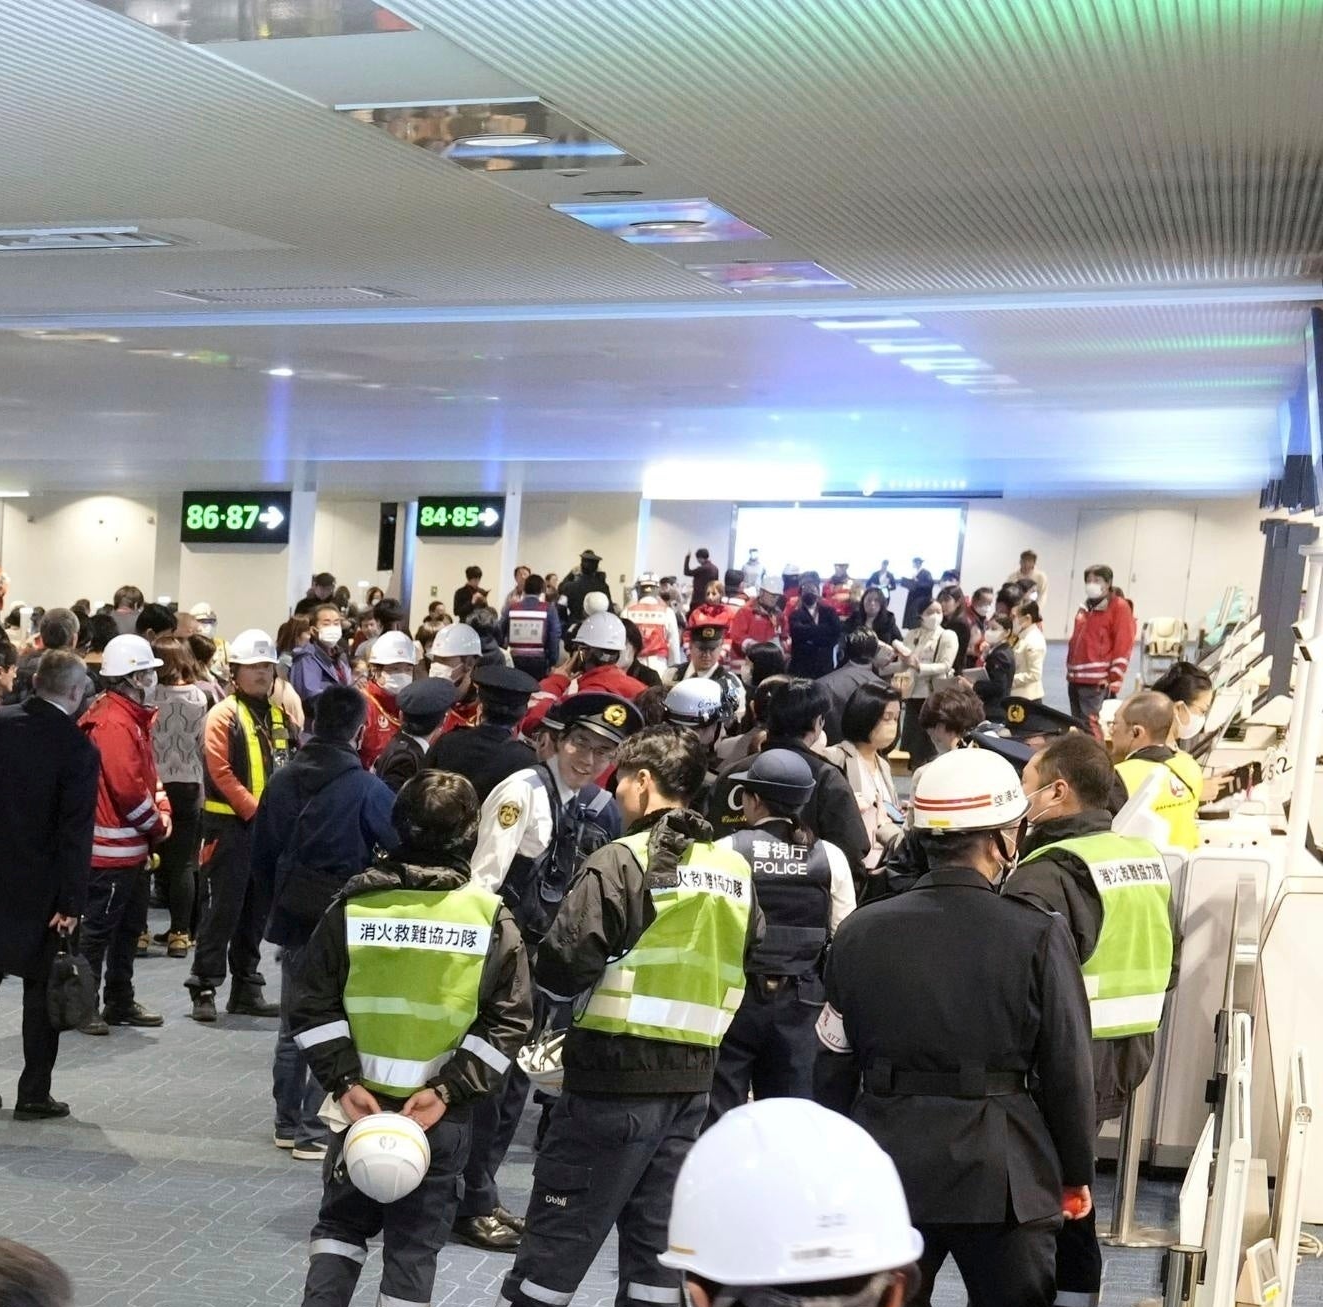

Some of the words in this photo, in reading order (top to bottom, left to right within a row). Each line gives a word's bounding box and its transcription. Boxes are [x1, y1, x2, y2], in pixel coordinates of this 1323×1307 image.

[752, 840, 808, 860] 警視庁
[753, 861, 808, 875] POLICE
[360, 922, 478, 948] 消火救難協力隊
